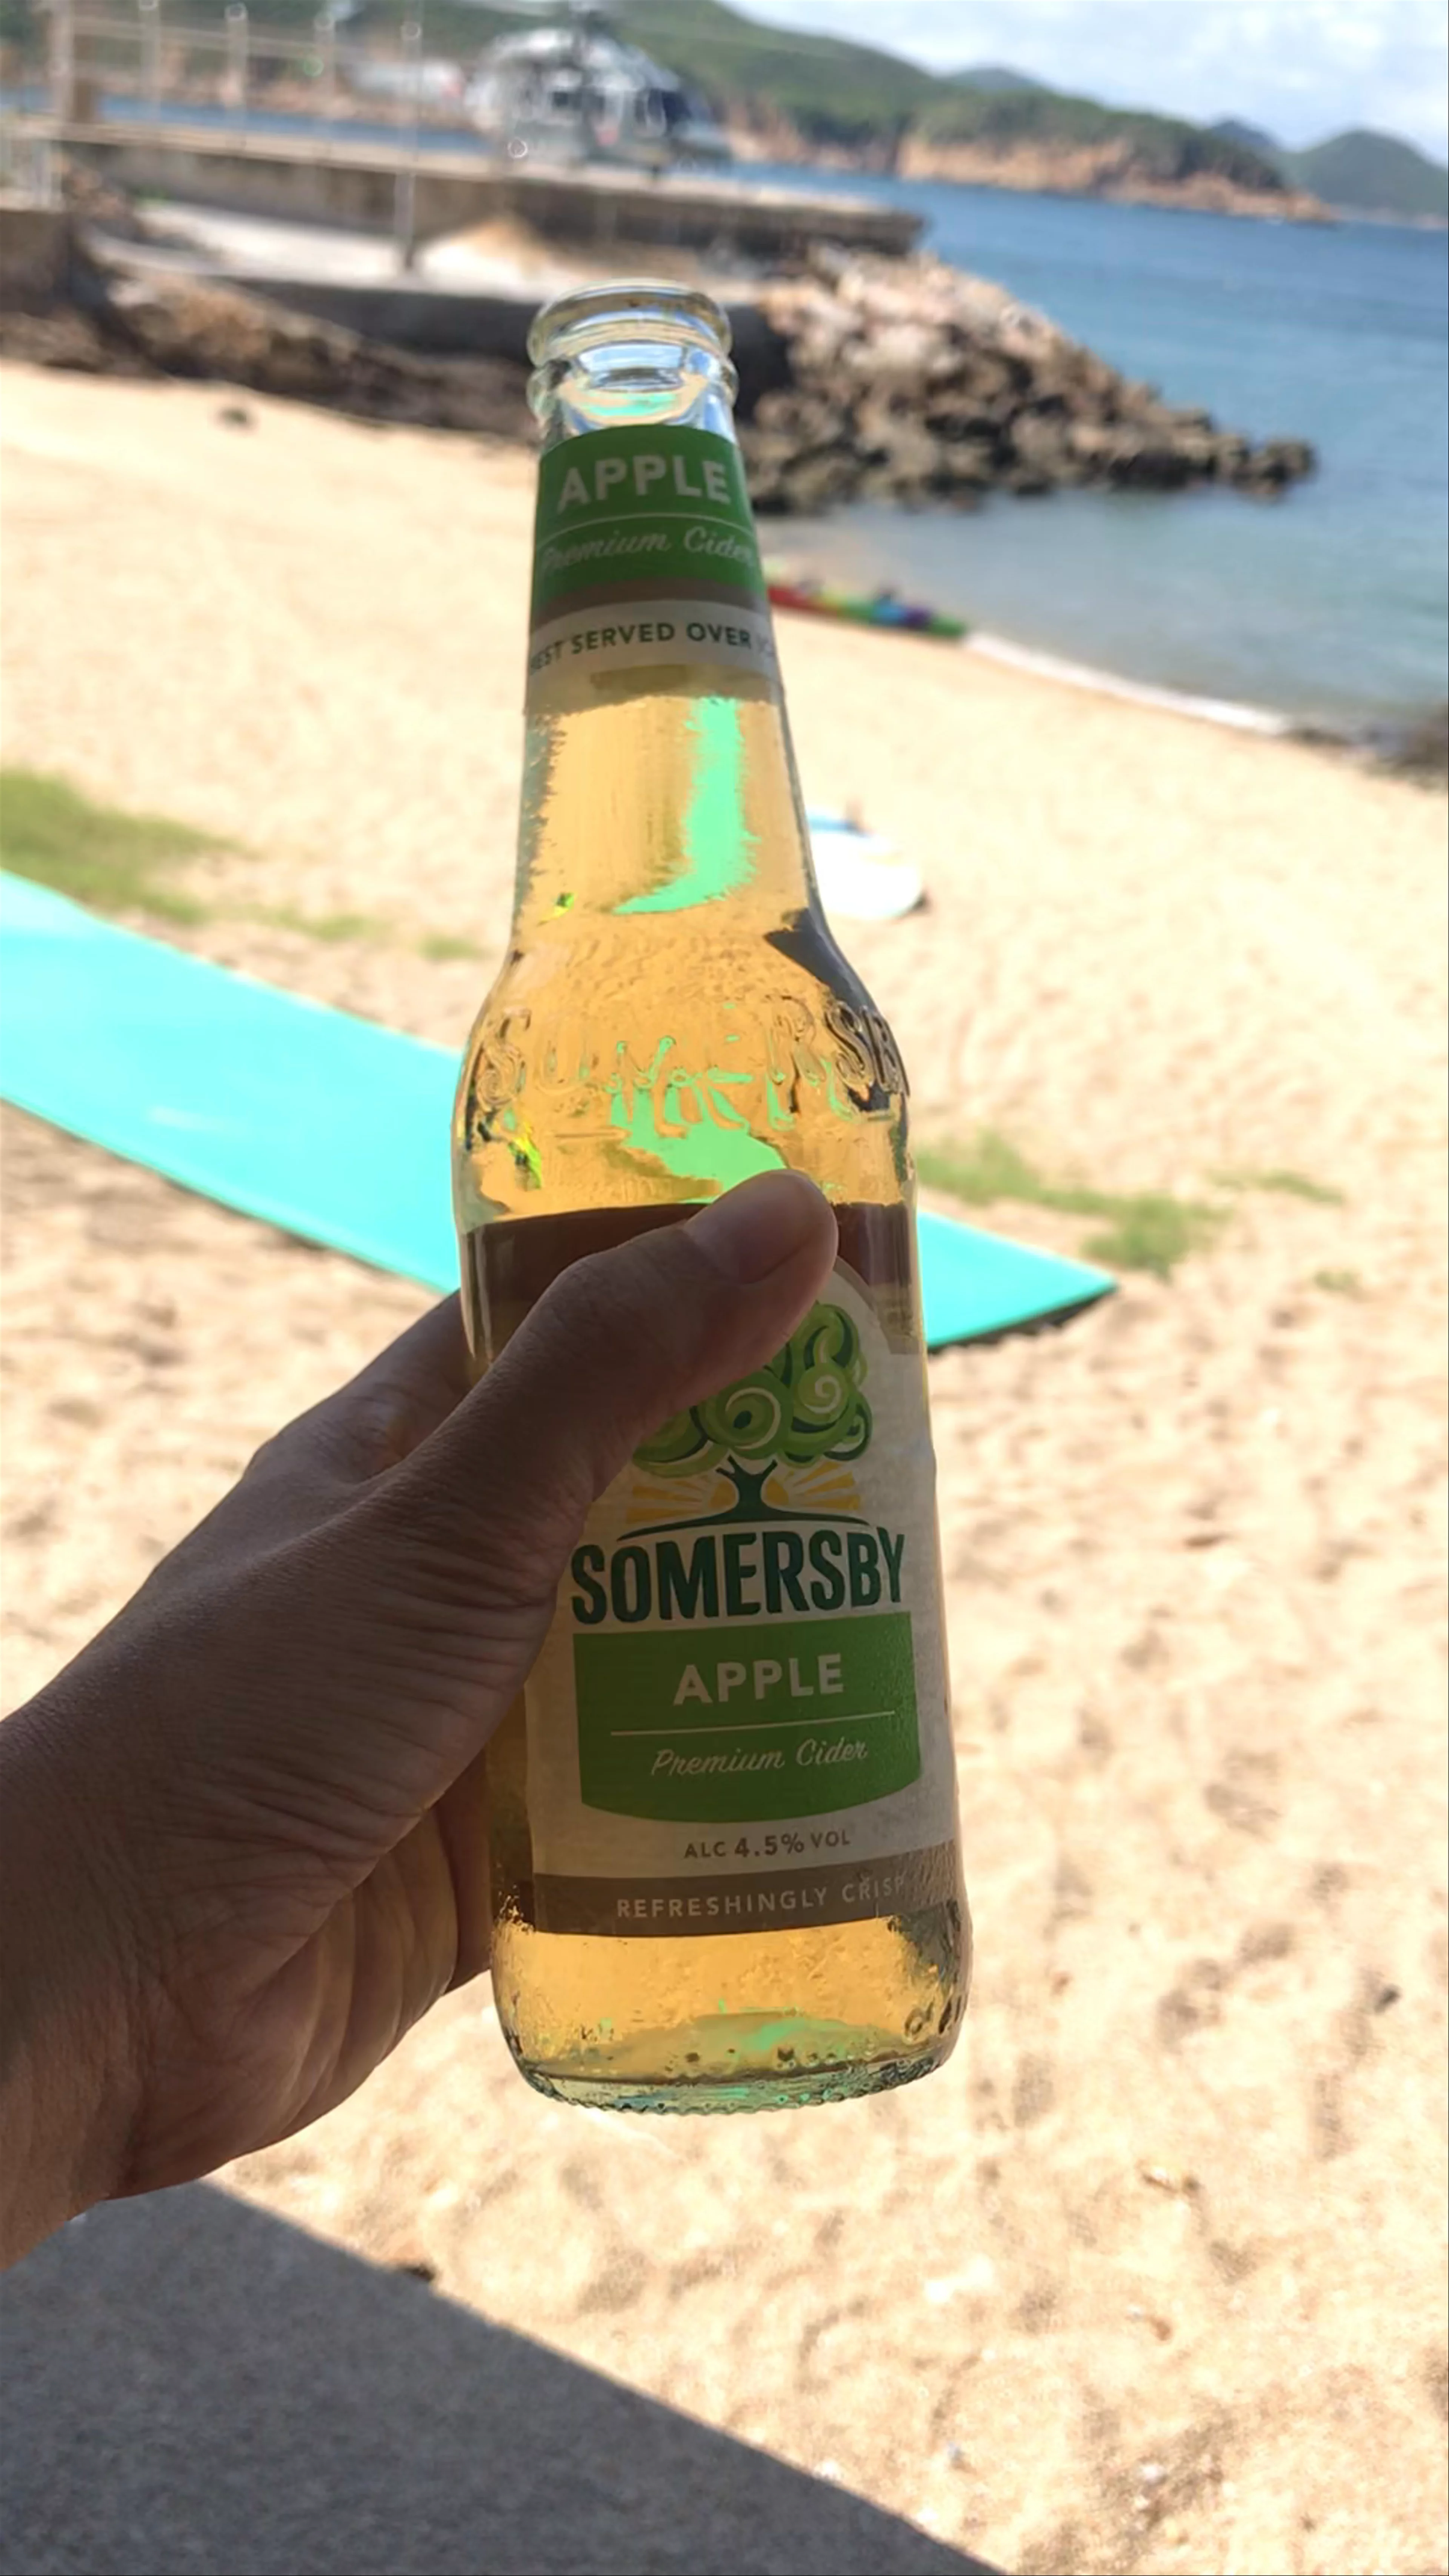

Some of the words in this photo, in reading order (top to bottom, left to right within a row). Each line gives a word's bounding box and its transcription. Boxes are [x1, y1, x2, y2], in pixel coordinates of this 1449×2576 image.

[557, 455, 731, 513] APPLE
[541, 530, 671, 571] Premium
[571, 623, 675, 655] SERVED
[686, 623, 752, 649] OVER
[570, 1527, 905, 1625] SOMERSBY
[673, 1653, 845, 1706] APPLE
[650, 1747, 785, 1776] Premium
[796, 1736, 869, 1767] Cider
[684, 1841, 727, 1858] ALC
[734, 1835, 804, 1857] 4.5%
[811, 1829, 850, 1848] VOL
[617, 1887, 826, 1918] REFRESHINGLY
[842, 1874, 904, 1902] CRISP
